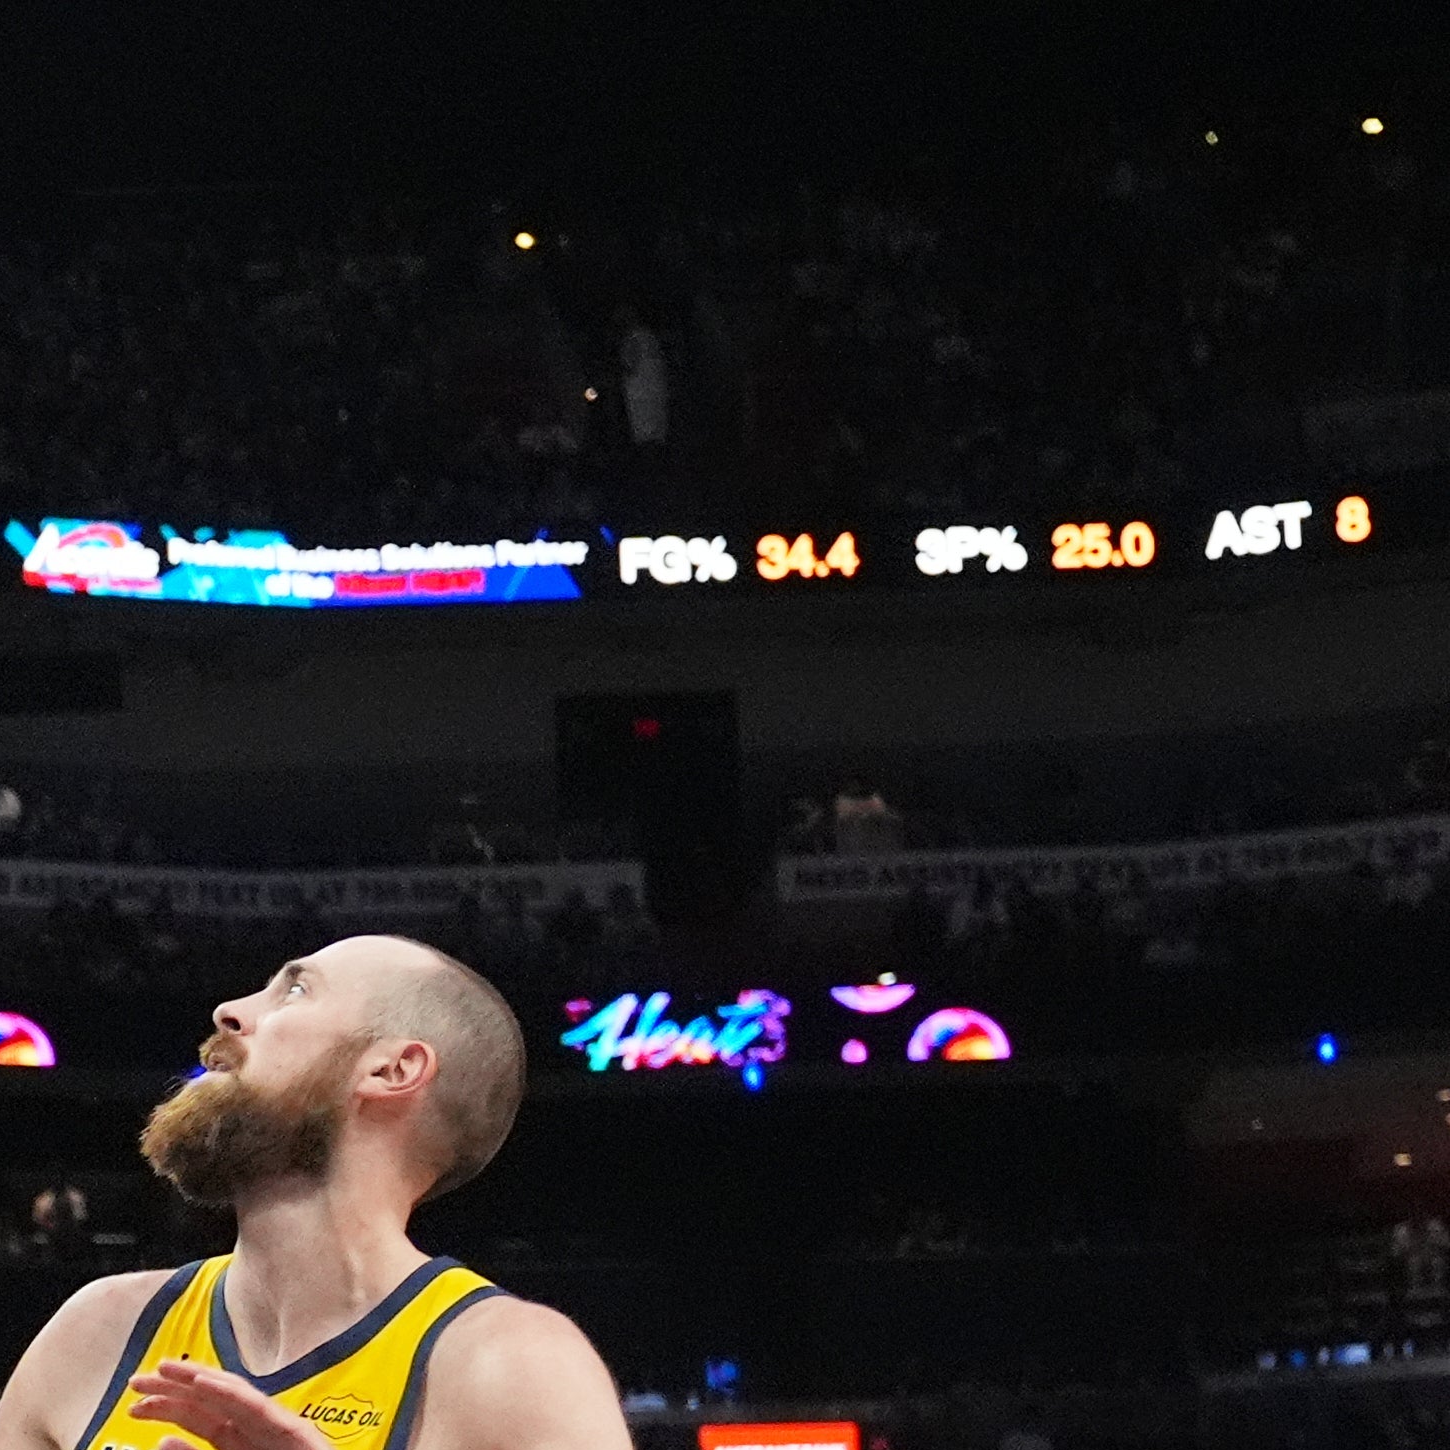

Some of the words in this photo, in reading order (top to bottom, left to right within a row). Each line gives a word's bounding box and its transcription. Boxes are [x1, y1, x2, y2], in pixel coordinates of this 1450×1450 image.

[619, 535, 738, 585] FG%
[756, 531, 860, 581] 34.4
[915, 525, 1029, 576] 3P%
[1051, 521, 1155, 569] 25.0
[1205, 500, 1313, 560] AST
[1335, 495, 1372, 543] 8
[299, 1402, 358, 1426] LUCAS
[358, 1410, 385, 1427] OIL
